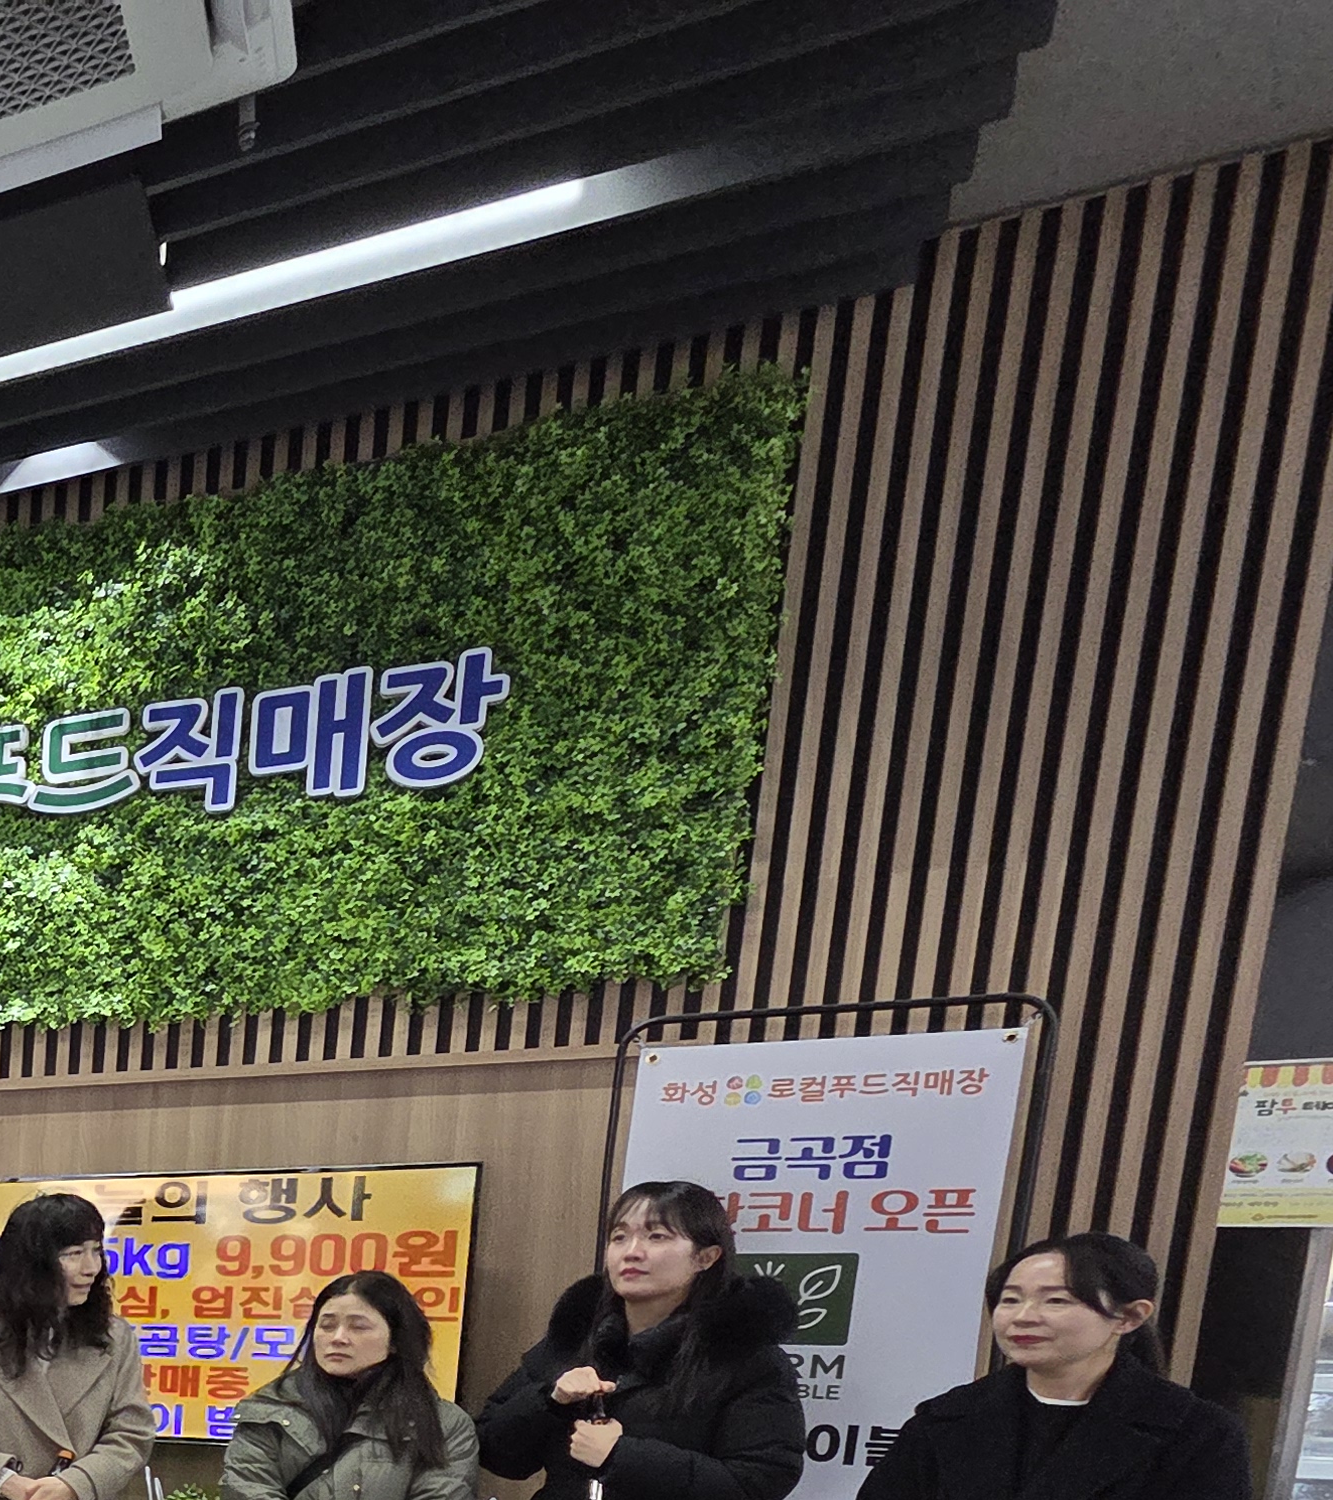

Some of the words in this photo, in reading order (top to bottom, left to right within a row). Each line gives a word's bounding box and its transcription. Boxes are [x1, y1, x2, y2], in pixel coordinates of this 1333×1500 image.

[661, 1079, 718, 1106] 화성
[767, 1068, 990, 1104] 로컬푸드직매장
[731, 1134, 893, 1181] 금곡점
[96, 1181, 209, 1225] 늘의
[237, 1175, 373, 1225] 행사
[864, 1188, 977, 1234] 오픈
[216, 1229, 461, 1280] 9,900원
[413, 1286, 460, 1322] 인
[792, 1354, 846, 1379] RM
